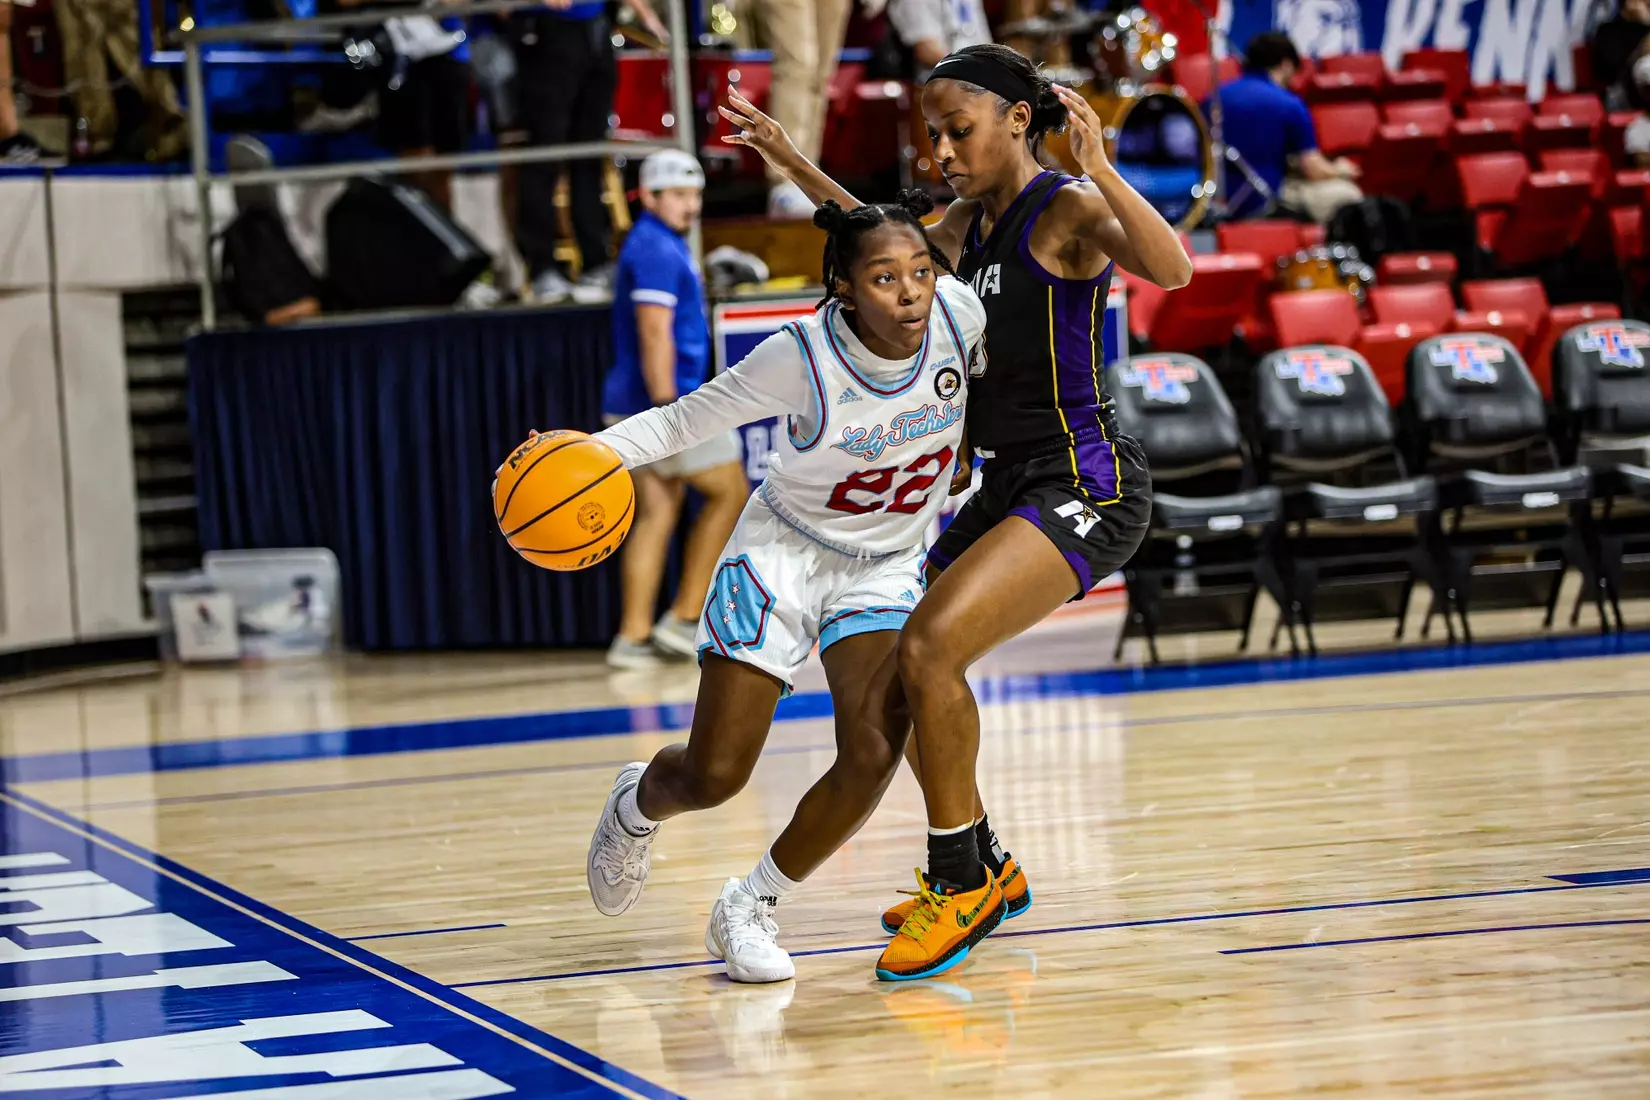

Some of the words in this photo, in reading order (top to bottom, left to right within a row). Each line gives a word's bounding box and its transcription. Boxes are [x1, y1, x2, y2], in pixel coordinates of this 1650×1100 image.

[837, 395, 863, 406] adidas
[830, 424, 888, 461] Lady
[825, 444, 953, 515] 22
